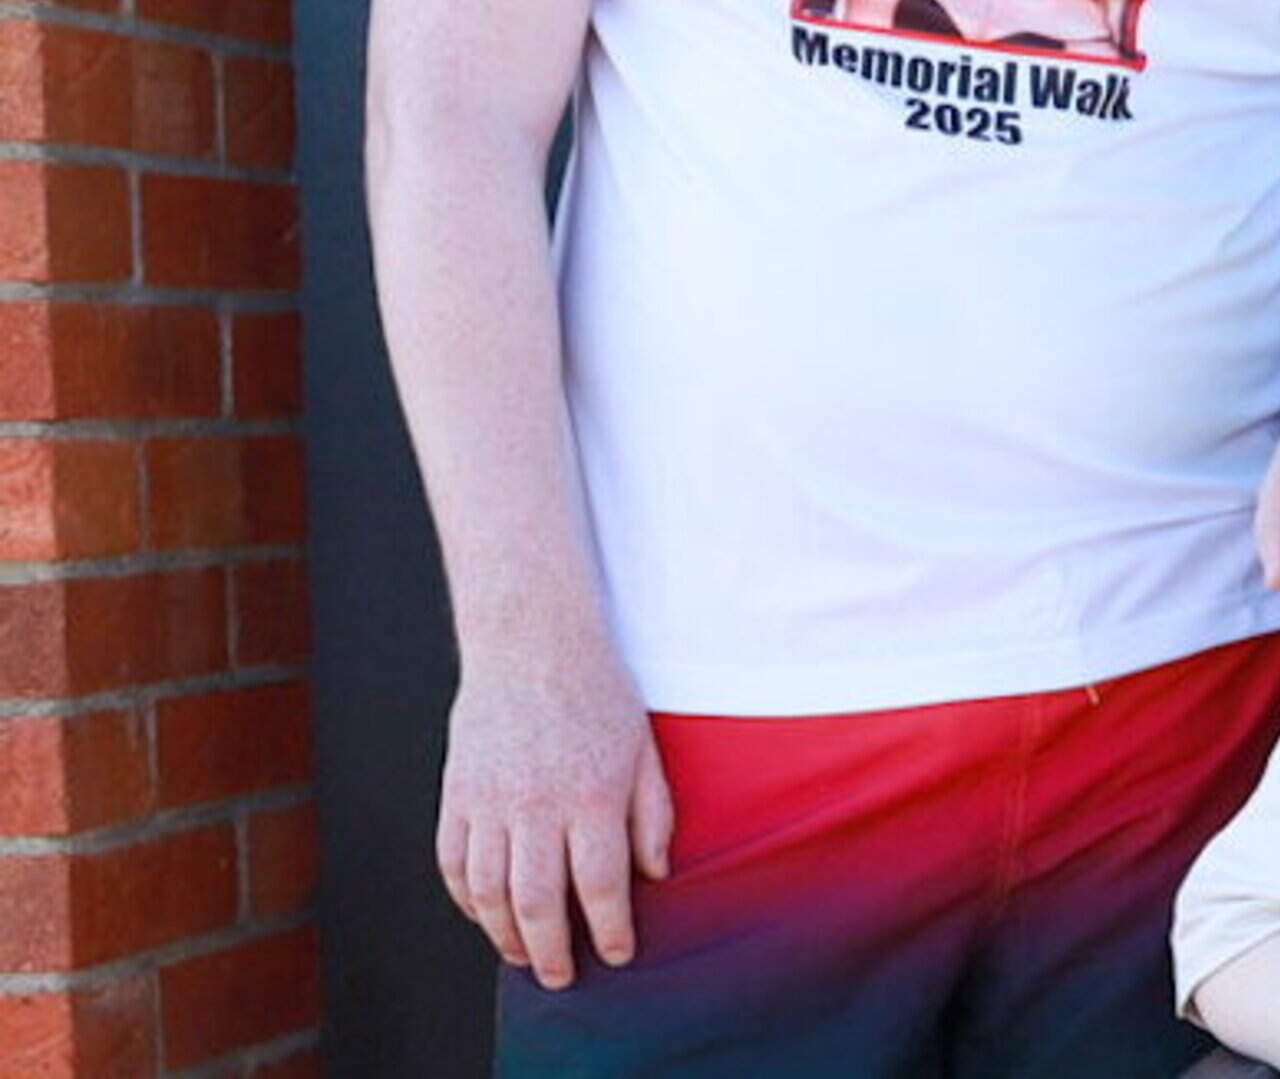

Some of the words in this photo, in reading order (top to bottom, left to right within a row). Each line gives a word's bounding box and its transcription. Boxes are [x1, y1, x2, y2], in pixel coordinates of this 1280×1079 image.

[790, 25, 1018, 107] Memorial
[1029, 64, 1134, 121] Walk
[904, 98, 1023, 146] 2025
